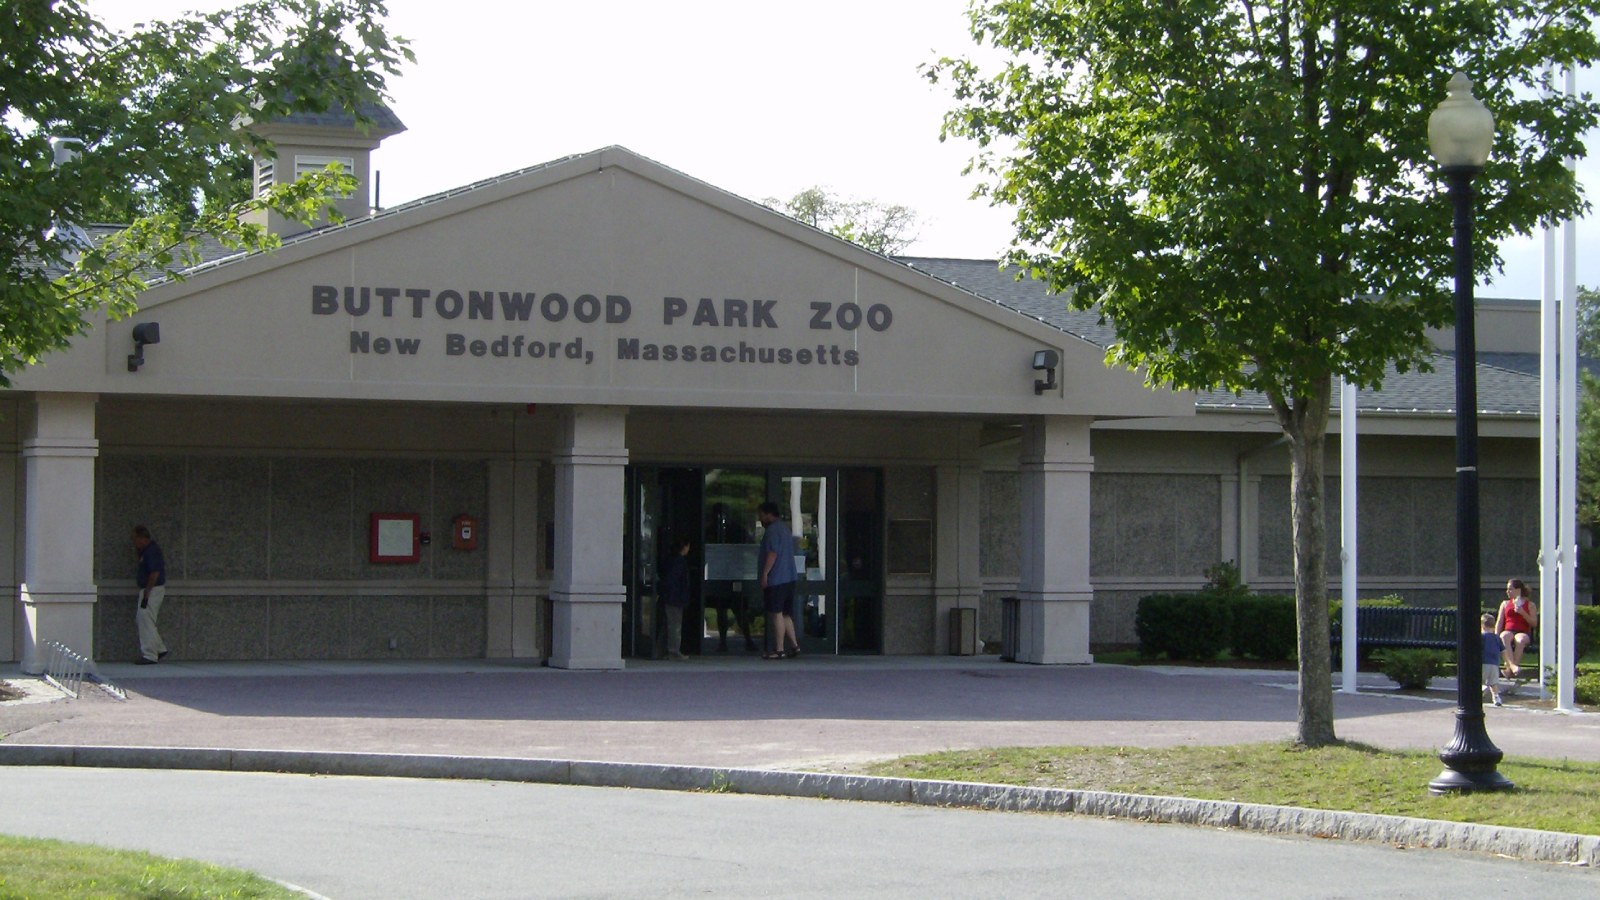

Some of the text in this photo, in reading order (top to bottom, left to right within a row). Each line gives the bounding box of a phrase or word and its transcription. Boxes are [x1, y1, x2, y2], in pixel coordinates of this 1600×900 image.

[312, 285, 893, 332] BUTTONWOOD PARK ZOO
[350, 331, 860, 366] New Bedford, Massachusetts
